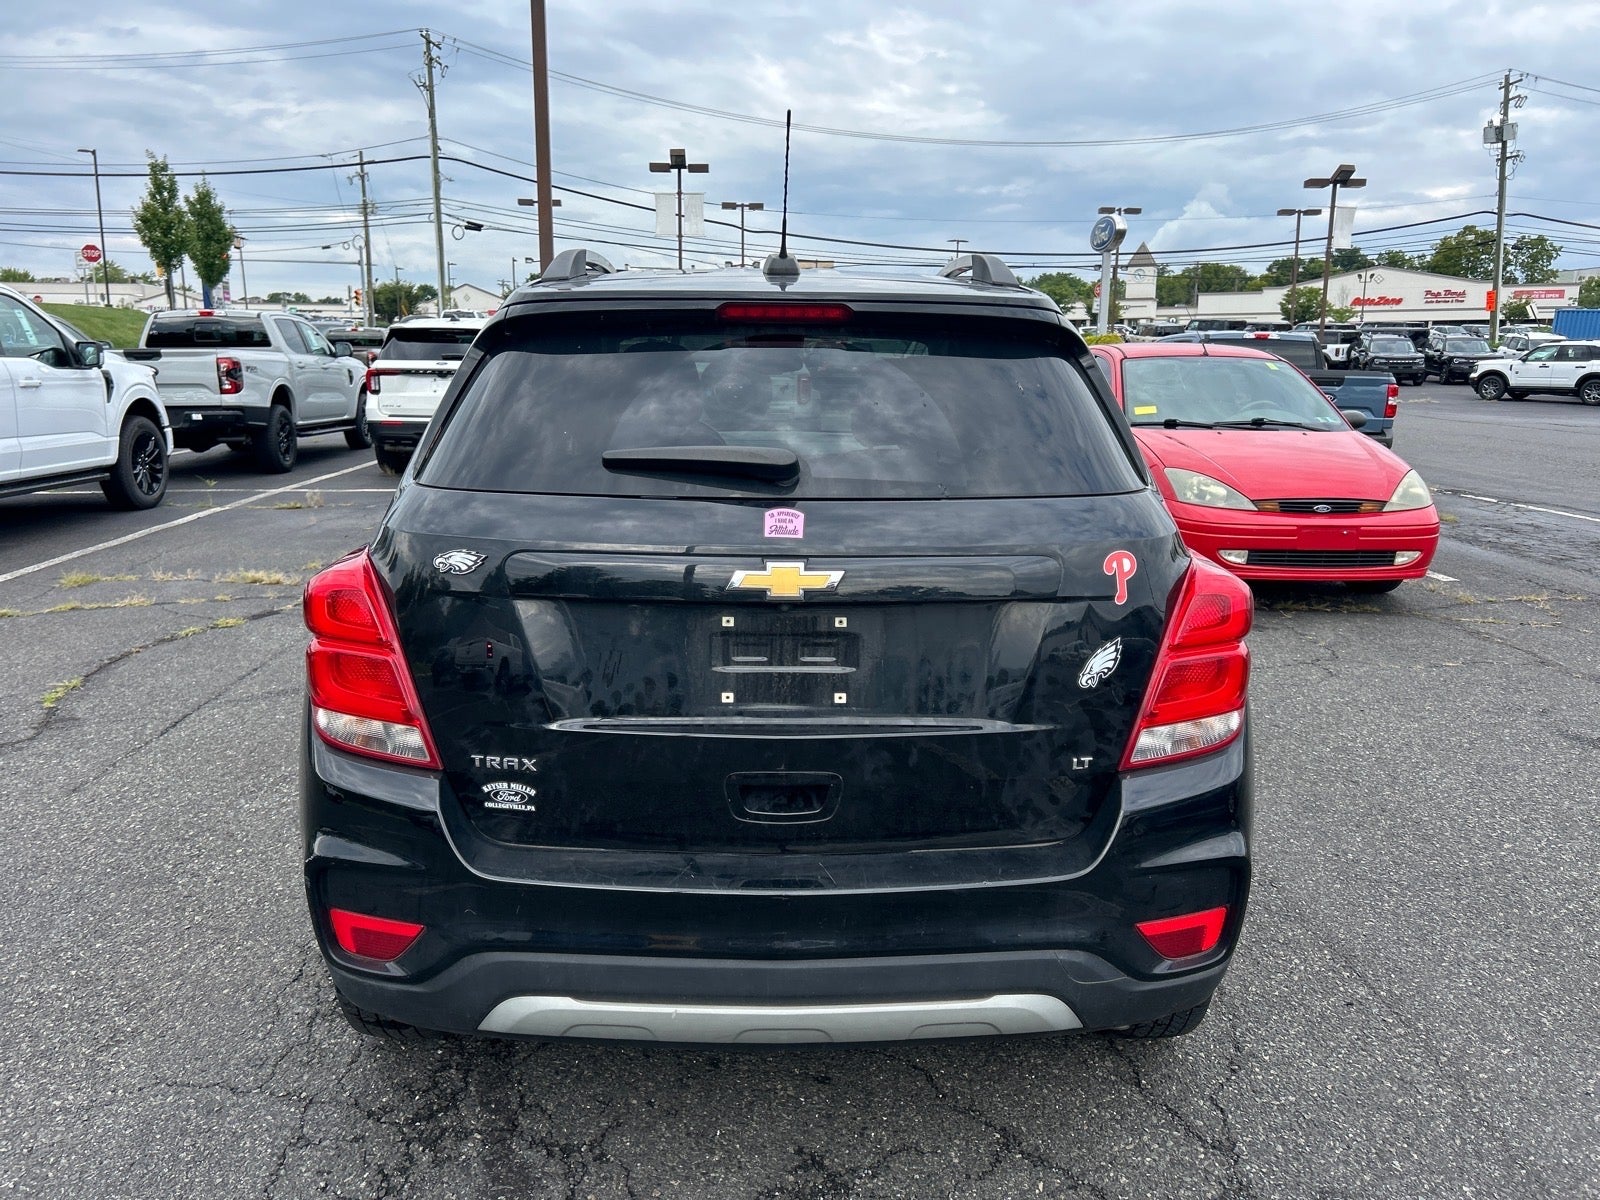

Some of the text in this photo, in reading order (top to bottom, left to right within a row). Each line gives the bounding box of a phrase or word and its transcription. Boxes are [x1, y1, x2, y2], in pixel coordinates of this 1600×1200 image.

[82, 249, 101, 258] STOP
[1350, 296, 1404, 306] AutoZone
[768, 524, 799, 535] Attitude
[471, 755, 537, 771] TRAX
[1072, 756, 1093, 770] LT
[482, 782, 537, 796] KEYSER MILLER
[497, 790, 522, 802] Ford
